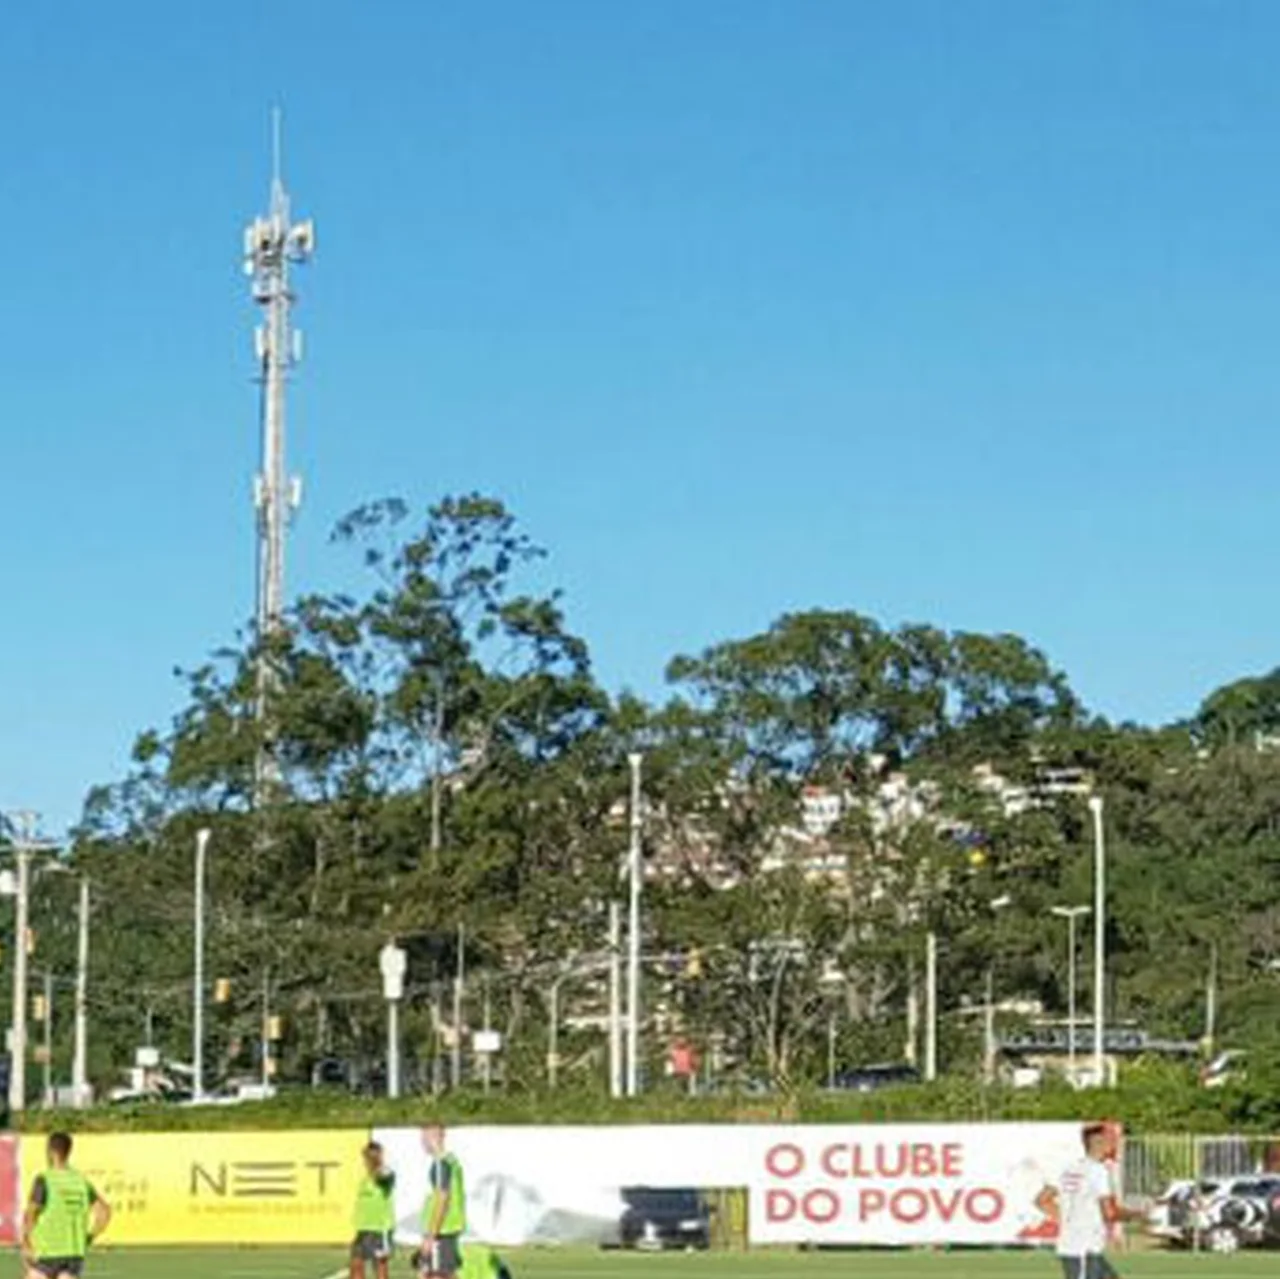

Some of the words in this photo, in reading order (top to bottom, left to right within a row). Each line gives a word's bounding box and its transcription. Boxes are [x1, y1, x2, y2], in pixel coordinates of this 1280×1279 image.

[765, 1143, 805, 1178] O
[820, 1143, 963, 1178] CLUBE
[190, 1161, 342, 1196] NET
[765, 1188, 840, 1223] DO
[858, 1188, 1004, 1223] POVO
